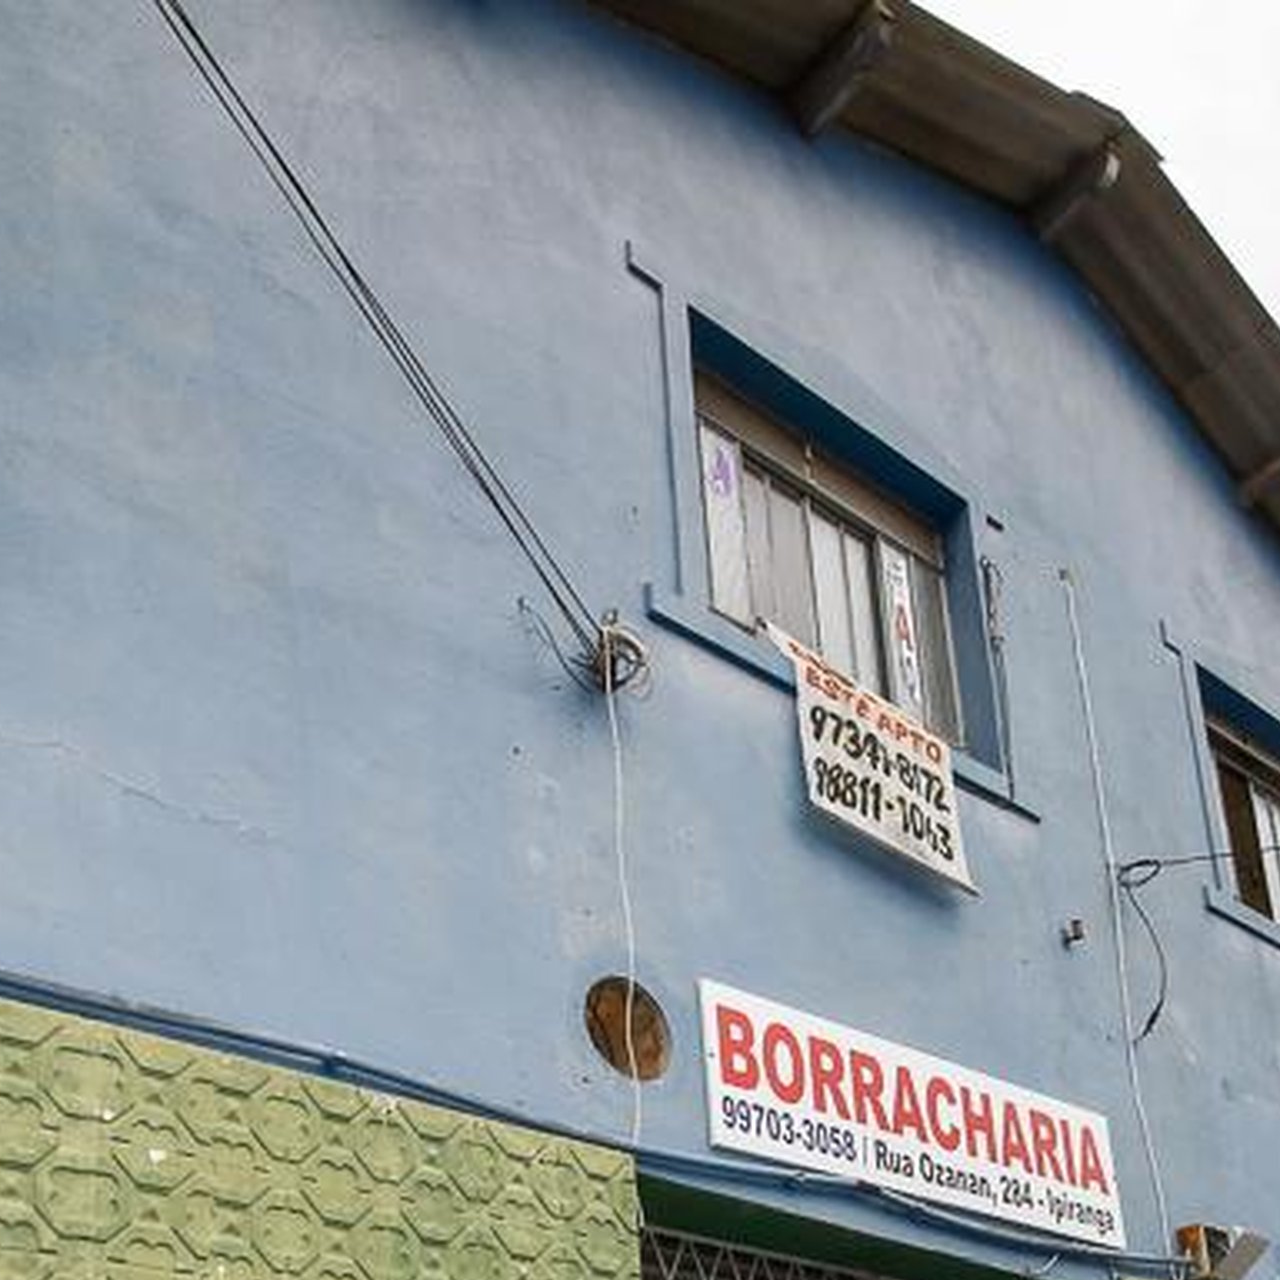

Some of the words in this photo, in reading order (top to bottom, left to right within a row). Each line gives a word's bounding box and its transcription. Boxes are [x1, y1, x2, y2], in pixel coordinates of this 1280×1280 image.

[877, 713, 942, 764] APTO
[716, 1003, 1109, 1195] BORRACHARIA
[721, 1096, 858, 1162] 99703-3058
[875, 1140, 914, 1178] Rua
[919, 1152, 996, 1208] Ozanan,
[1046, 1187, 1114, 1235] Ipiranga
